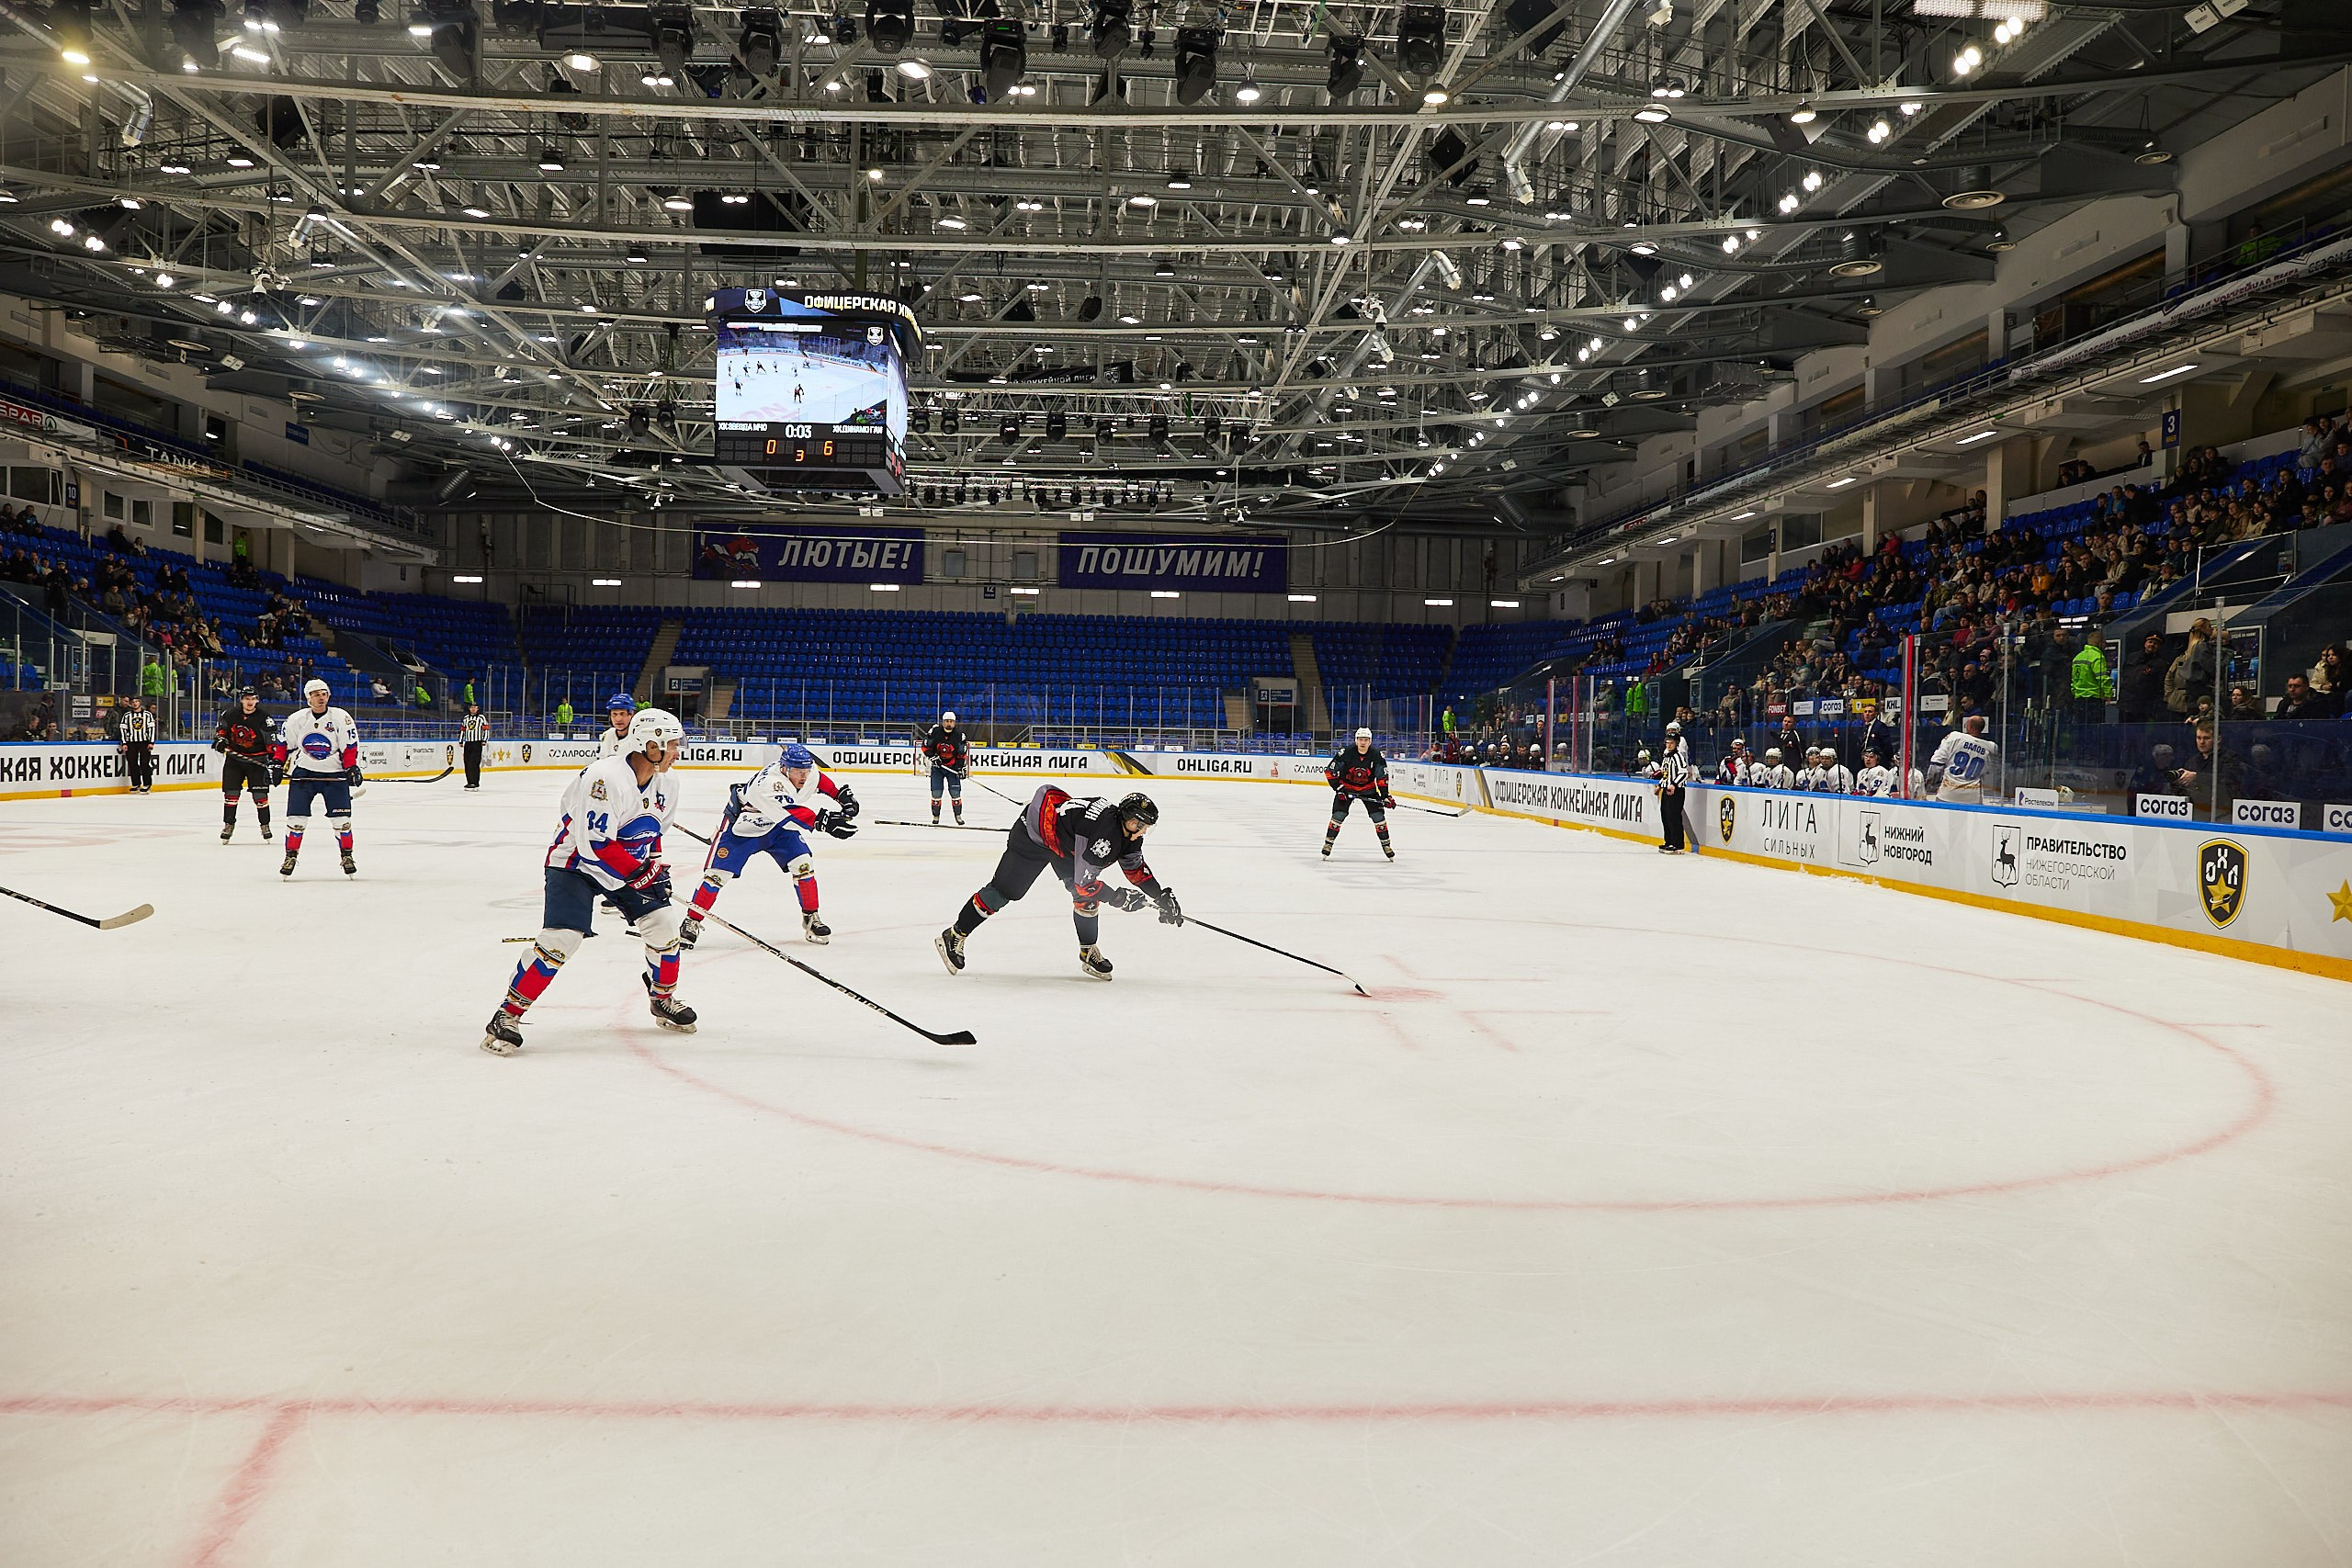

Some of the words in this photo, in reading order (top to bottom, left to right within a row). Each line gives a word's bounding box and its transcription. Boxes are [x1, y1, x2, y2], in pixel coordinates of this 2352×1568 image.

[804, 295, 897, 313] ОФИЦЕРСКАЯ
[785, 424, 813, 439] 0:03
[2168, 415, 2175, 433] 3
[766, 440, 776, 454] 0
[795, 449, 804, 462] 3
[823, 440, 833, 456] 6
[68, 486, 76, 499] 10
[777, 539, 911, 570] ЛЮТЫЕ!
[1076, 547, 1264, 578] ПОШУМИМ!
[346, 728, 356, 739] 15
[678, 749, 742, 761] LIGA.RU
[1963, 741, 1986, 756] ВАЛОВ
[0, 757, 41, 782] КАЯ
[50, 748, 160, 780] ХОККЕЙЯ
[166, 753, 206, 775] ЛИГА
[1048, 755, 1088, 769] ЛИГА
[1177, 758, 1253, 773] OHLIGA.RU
[1951, 751, 1985, 780] 90
[1495, 780, 1548, 808] ОФИЦЕРСКАЯ
[1550, 783, 1609, 818] ХОККЕЙНАЯ
[1613, 793, 1643, 823] ЛИГА
[2024, 796, 2055, 807] Ростелеком
[586, 810, 609, 834] 34
[1762, 799, 1817, 834] ЛИГА
[1884, 826, 1924, 843] НИЖНИЙ
[1764, 838, 1815, 859] СИЛЬНЫХ
[1884, 844, 1933, 866] НОВГОРОД
[2027, 836, 2127, 860] ПРАВИТЕЛЬСТВО
[2026, 858, 2115, 881] НИЖЕГОРОДСКОЙ
[2025, 873, 2070, 891] ОБЛАСТИ
